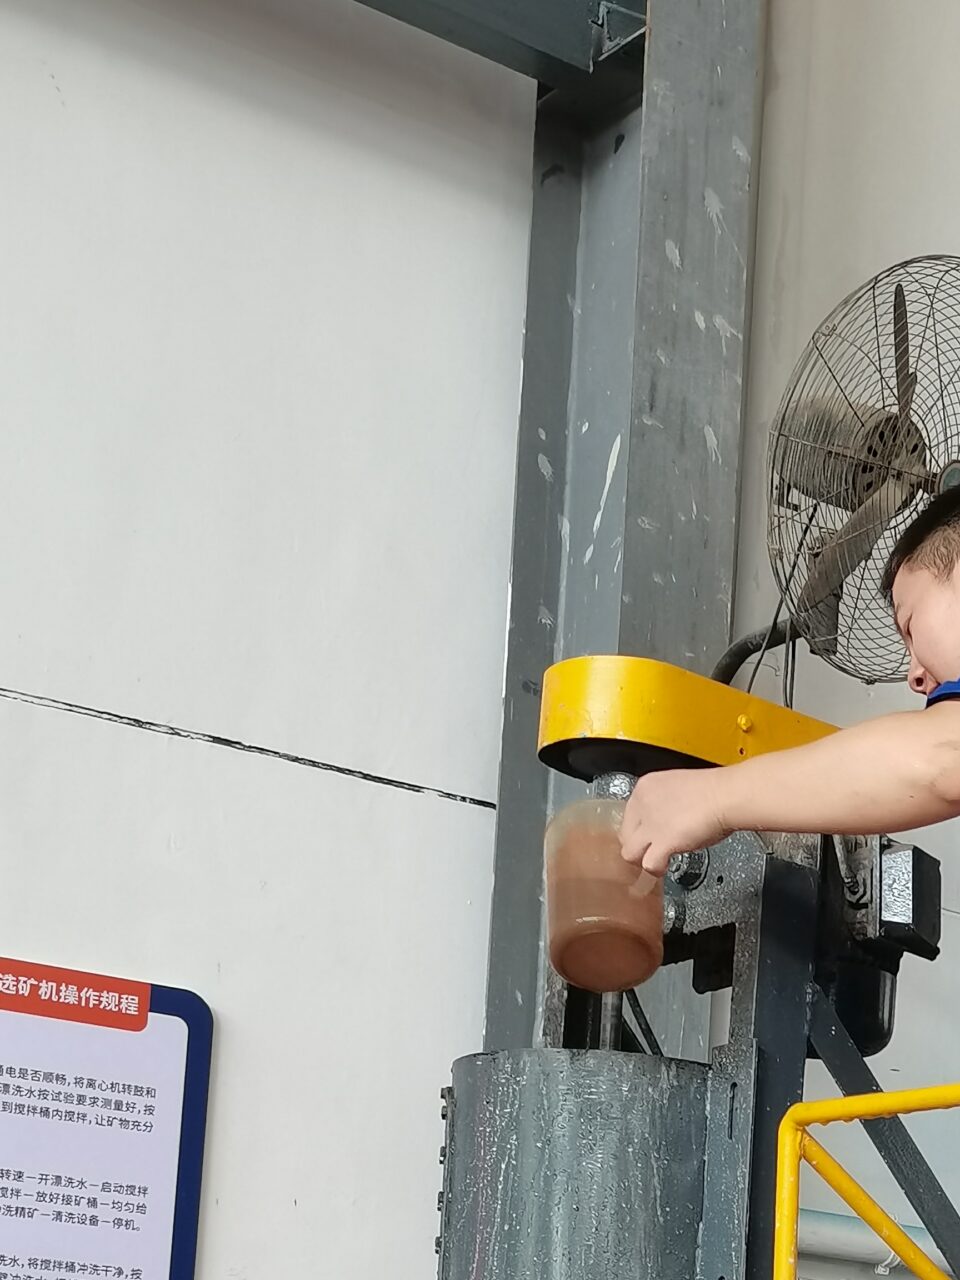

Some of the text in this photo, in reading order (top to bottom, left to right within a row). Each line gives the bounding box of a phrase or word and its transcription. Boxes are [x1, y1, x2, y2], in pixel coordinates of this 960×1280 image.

[0, 972, 140, 1015] 选矿机操作规程
